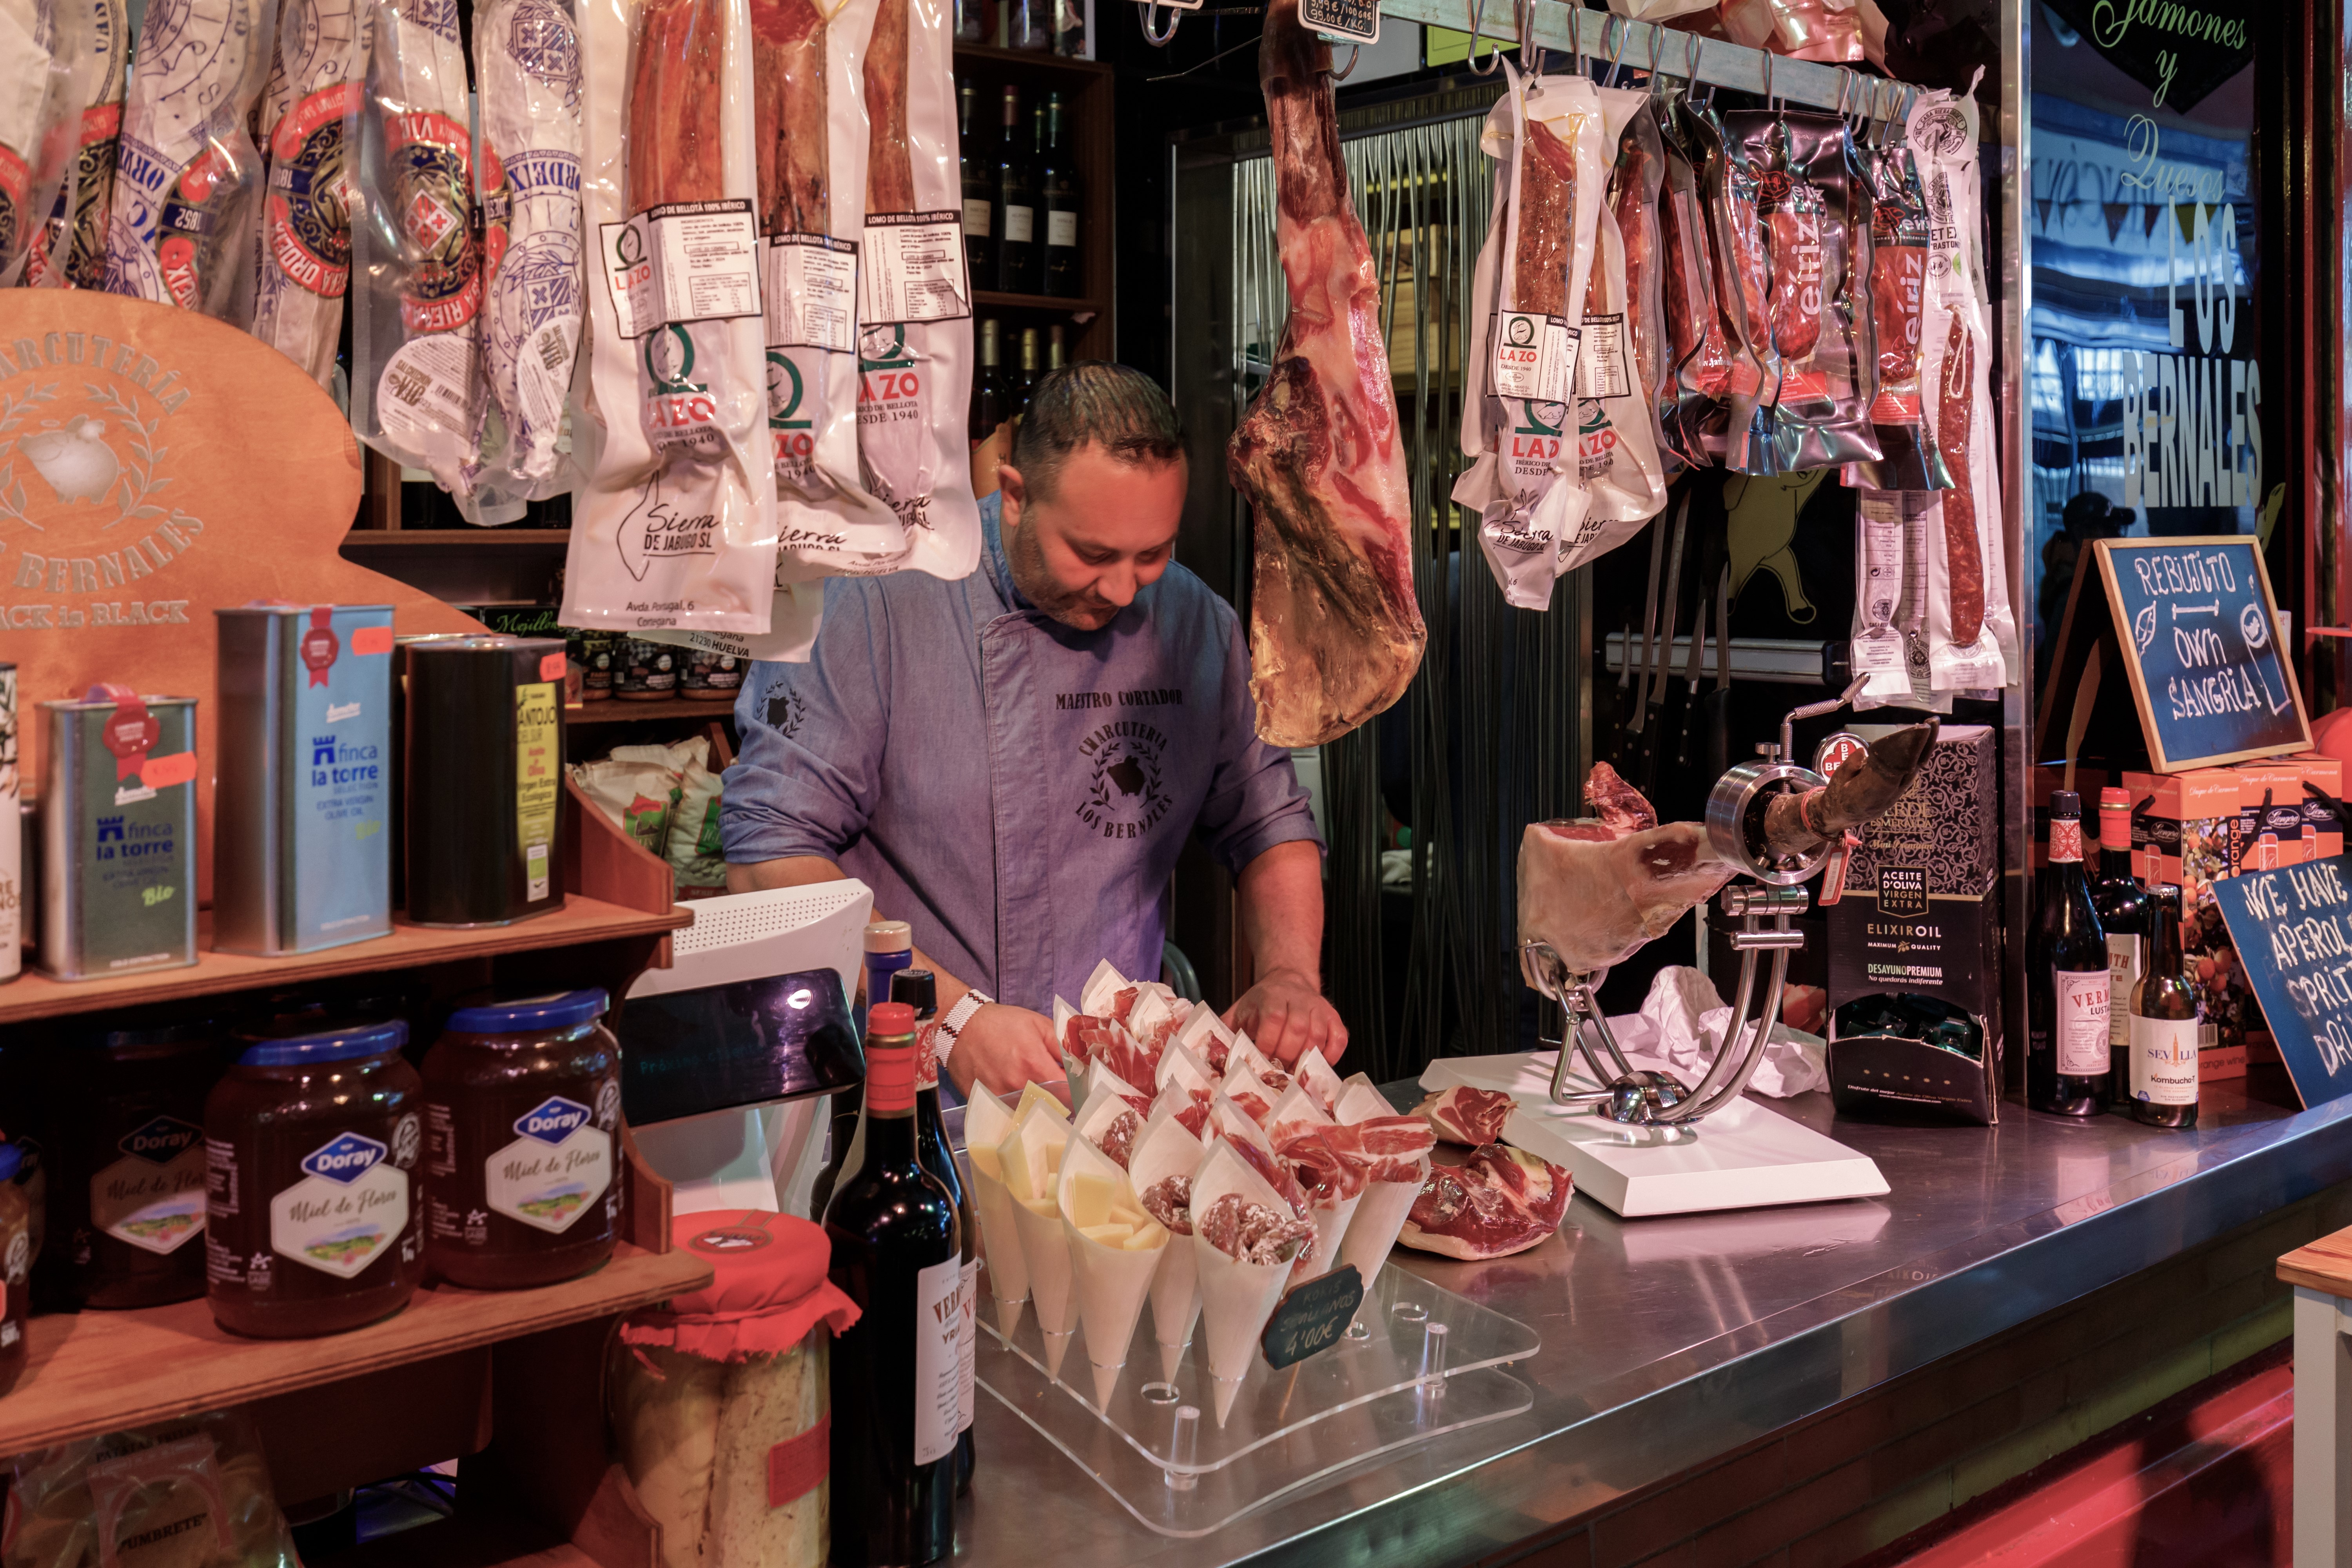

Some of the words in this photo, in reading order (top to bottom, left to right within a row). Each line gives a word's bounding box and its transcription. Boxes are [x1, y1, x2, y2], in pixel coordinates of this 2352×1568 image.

[2152, 49, 2178, 108] y
[1920, 110, 1934, 125] CASA
[2120, 113, 2225, 202] Quesos
[868, 214, 887, 224] LOMO
[888, 214, 895, 223] DE
[615, 265, 651, 290] LAZO
[1788, 220, 1820, 315] eíriz
[2169, 195, 2236, 354] LOS
[1499, 348, 1537, 362] LAZO
[859, 372, 919, 403] AZO
[887, 401, 918, 411] BELLOTA
[857, 413, 886, 425] ESDE
[893, 409, 918, 421] 1940
[2122, 352, 2263, 508] BERNALES
[646, 503, 720, 534] Sierra
[1499, 520, 1553, 542] Sierra
[13, 508, 204, 593] BERNALES
[644, 534, 660, 550] DE
[663, 533, 696, 551] JABUGO
[698, 532, 713, 548] SL
[1509, 538, 1537, 552] JABUGO
[91, 600, 190, 626] BLACK
[688, 600, 695, 611] 6
[712, 639, 750, 657] HUELVA
[1055, 691, 1112, 710] MAESTRO
[1118, 689, 1183, 706] CORTADOR
[518, 706, 557, 726] ANTOJO
[339, 743, 378, 762] finca
[312, 769, 327, 787] la
[332, 764, 379, 784] torre
[2240, 773, 2260, 786] Duque
[2260, 774, 2268, 782] de
[2267, 772, 2297, 782] Carmona
[2305, 766, 2338, 775] Carmona
[2189, 786, 2207, 798] Duque
[2213, 784, 2239, 793] Carmona
[1074, 800, 1102, 831] LOS
[1103, 793, 1174, 840] BERNALES
[128, 822, 173, 840] finca
[97, 845, 115, 861] la
[121, 839, 173, 858] torre
[1870, 839, 1891, 849] Mini
[1893, 839, 1933, 850] Premium
[1882, 871, 1921, 880] ACEITE
[142, 885, 176, 907] Bio
[1883, 890, 1922, 899] VIRGEN
[2242, 873, 2287, 921] WE
[2288, 862, 2348, 911] HAVE
[1884, 899, 1923, 909] EXTRA
[1867, 923, 1942, 938] ELIXIROIL
[1868, 963, 1942, 978] DESAYUNOPREMIUM
[1878, 975, 1907, 984] quedarás
[1908, 977, 1943, 985] indiferente
[2227, 1055, 2246, 1065] wine
[527, 1110, 583, 1132] Doray
[132, 1130, 192, 1151] Doray
[316, 1147, 378, 1172] Doray
[502, 1156, 541, 1181] Miel
[546, 1154, 561, 1173] de
[564, 1148, 602, 1173] Flores
[107, 1177, 145, 1198] Miel
[152, 1174, 169, 1191] de
[289, 1198, 331, 1223] Miel
[334, 1196, 354, 1214] de
[357, 1188, 397, 1214] Flores
